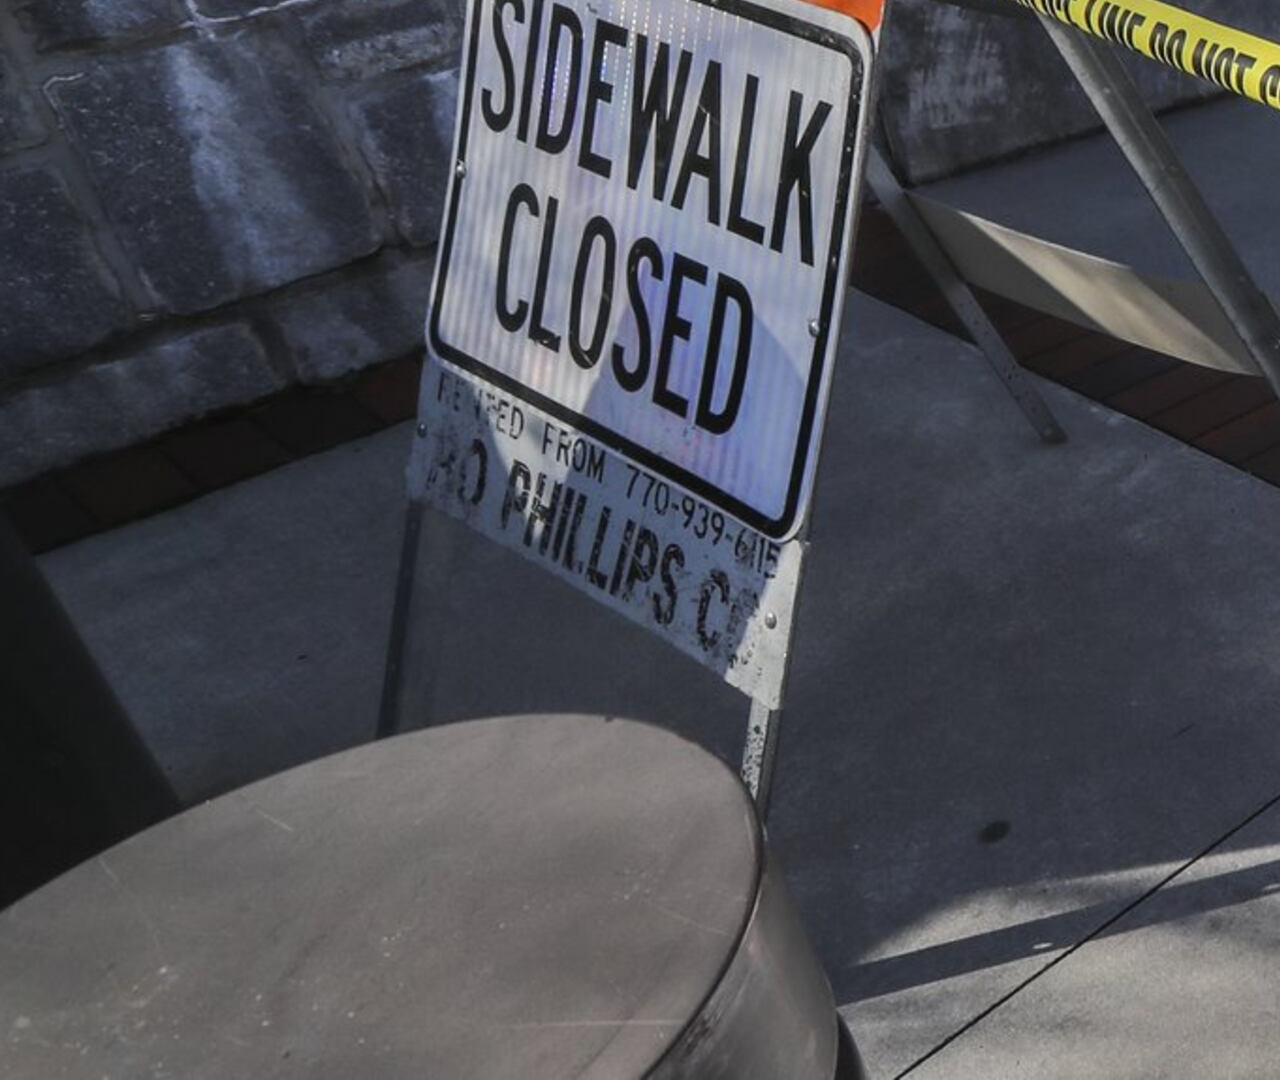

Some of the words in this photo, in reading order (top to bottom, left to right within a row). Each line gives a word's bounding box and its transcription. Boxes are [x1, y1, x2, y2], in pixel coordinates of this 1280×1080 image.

[496, 183, 753, 435] CLOSED
[542, 423, 606, 484] FROM
[502, 460, 684, 625] PHILLIPS
